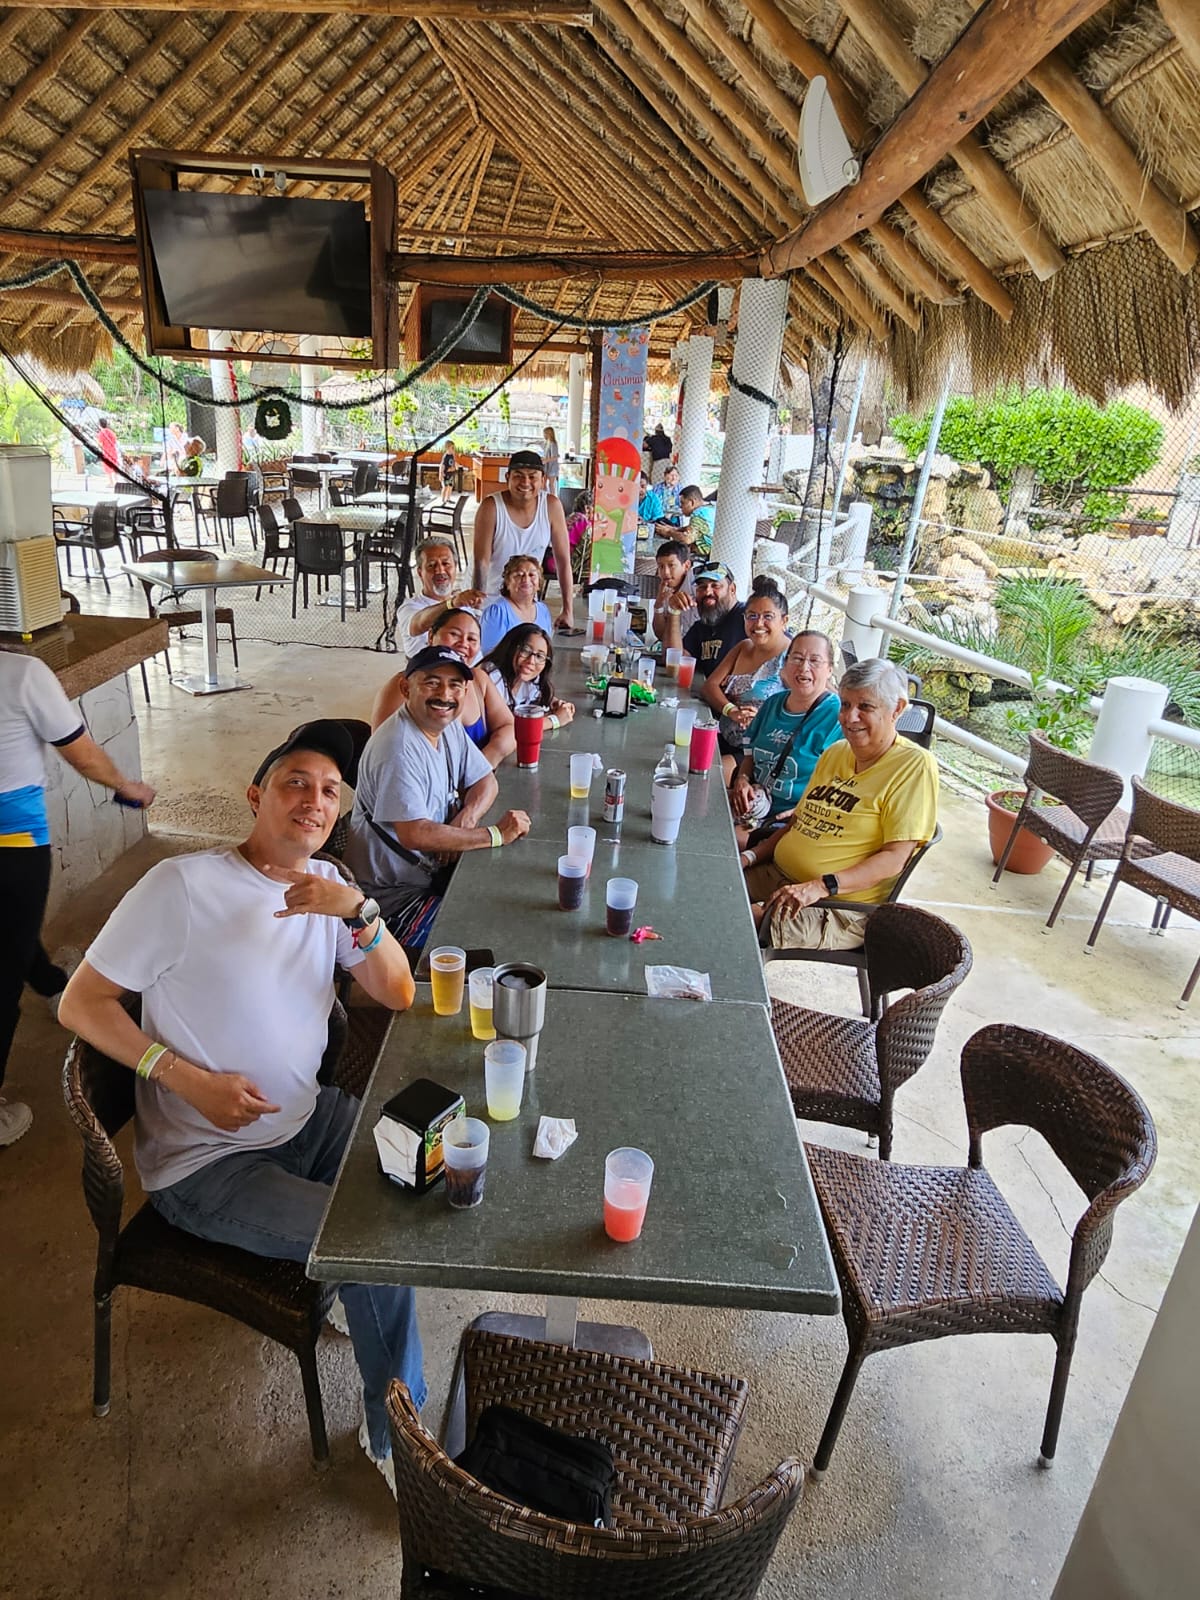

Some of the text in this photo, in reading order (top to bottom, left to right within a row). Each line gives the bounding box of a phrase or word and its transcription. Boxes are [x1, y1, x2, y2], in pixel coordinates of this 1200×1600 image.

[603, 372, 643, 385] Christmas
[804, 801, 831, 817] MEXICO
[814, 819, 844, 838] DEPT.
